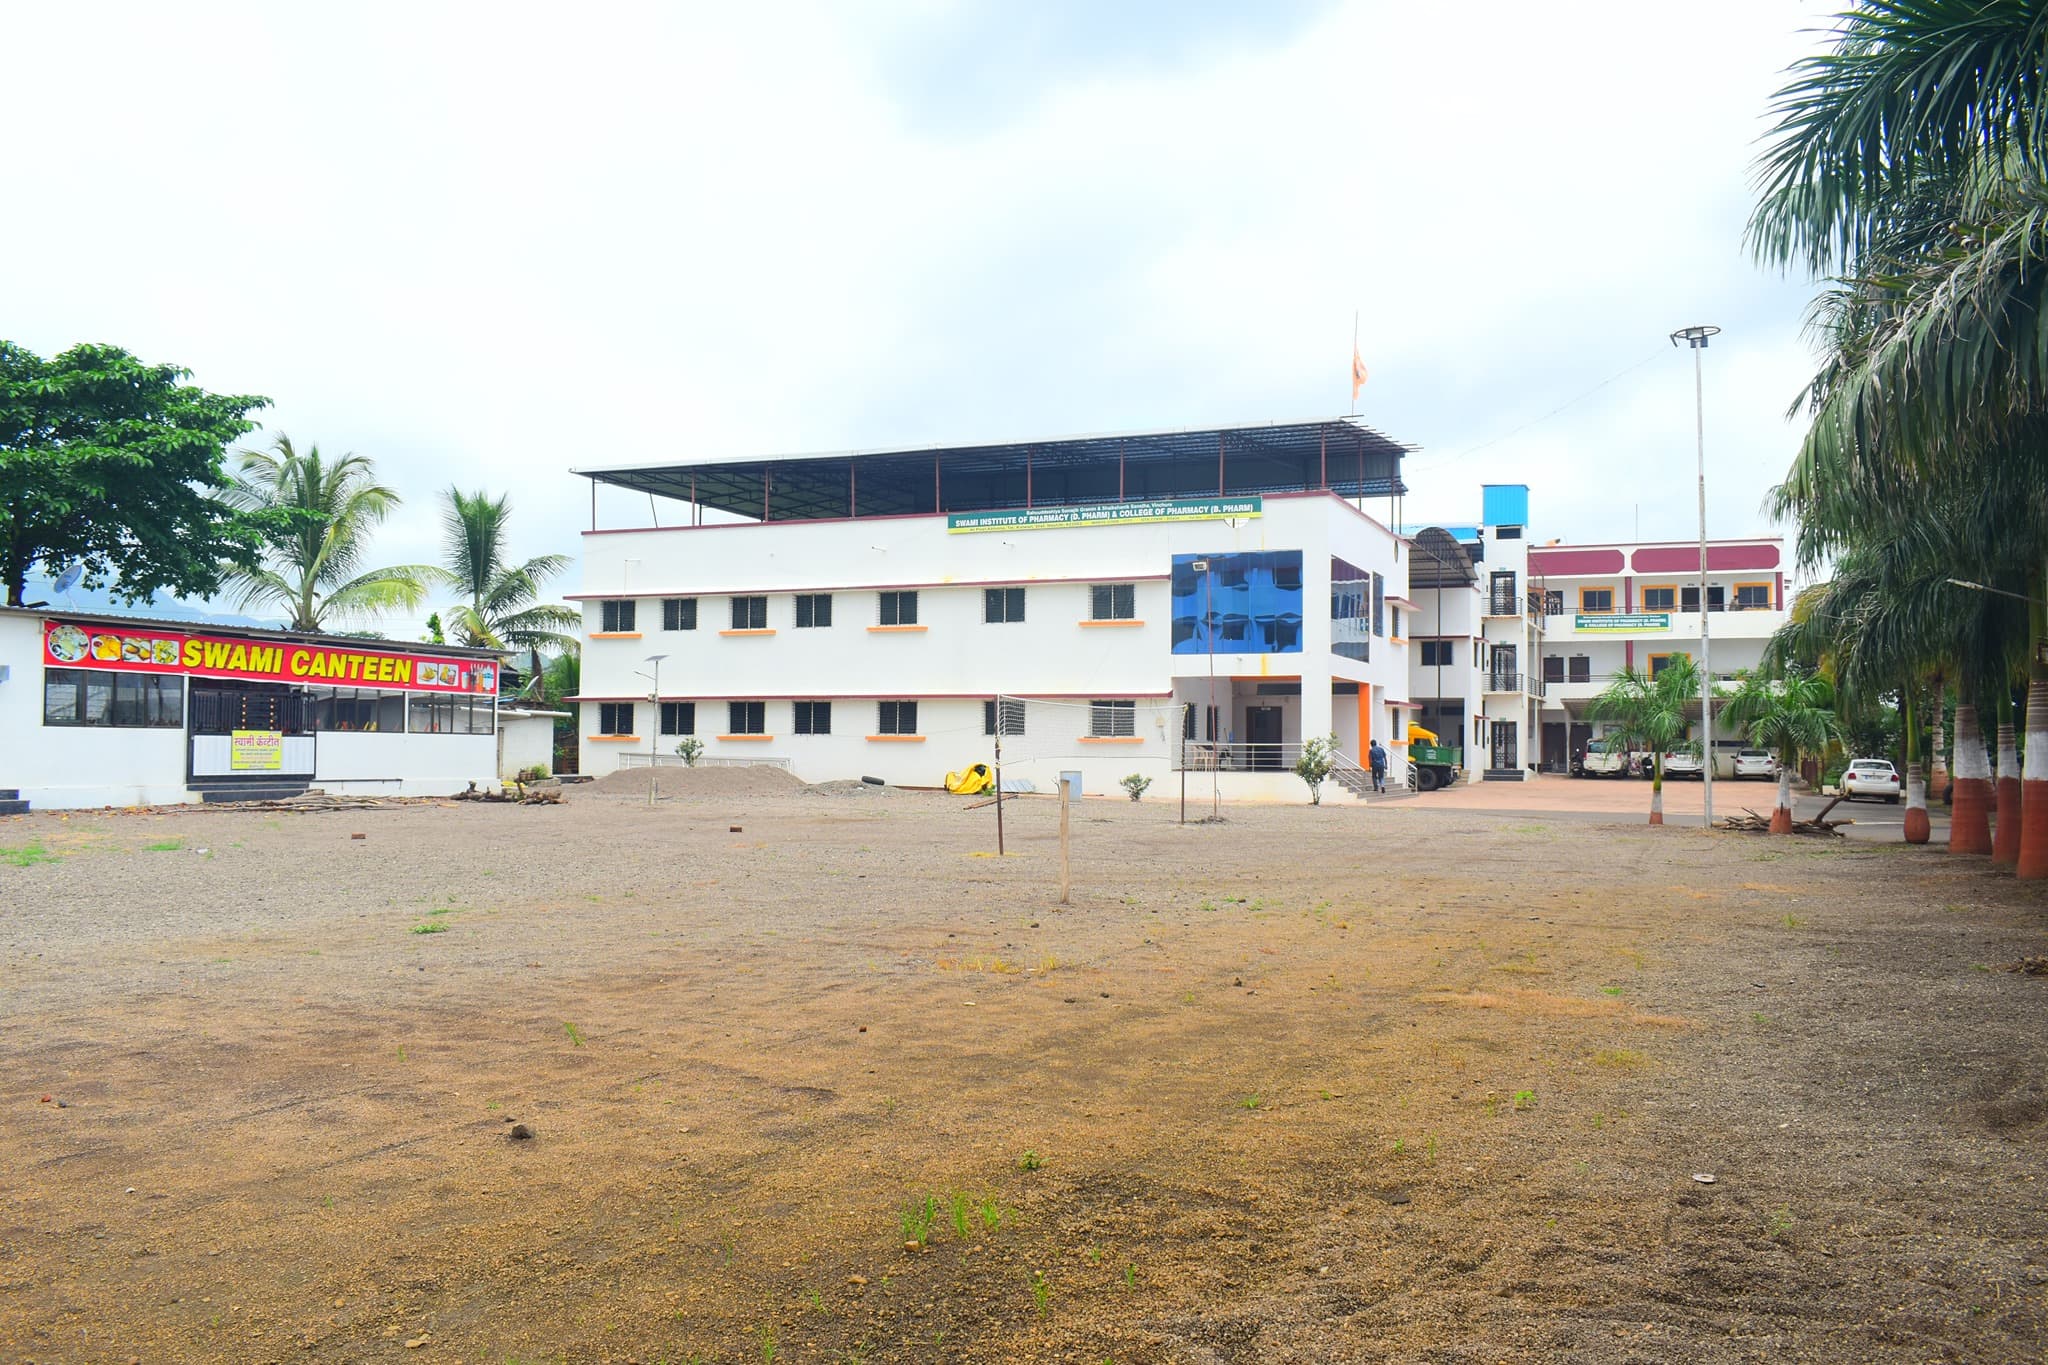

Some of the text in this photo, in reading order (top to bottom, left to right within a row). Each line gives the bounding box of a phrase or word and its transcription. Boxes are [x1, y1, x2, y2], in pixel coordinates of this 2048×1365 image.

[955, 519, 978, 527] SWAMI
[980, 517, 1016, 526] INSTITUTE
[1029, 513, 1069, 523] PHARMACY
[1070, 512, 1079, 521] (D.
[1081, 511, 1110, 520] PHARM)
[1119, 508, 1153, 517] COLLEGE
[1155, 507, 1165, 515] OF
[1167, 505, 1209, 514] PHARMACY
[1210, 504, 1221, 513] (B.
[1222, 503, 1253, 513] PHARM)
[182, 639, 412, 683] SWAMI CANTEEN
